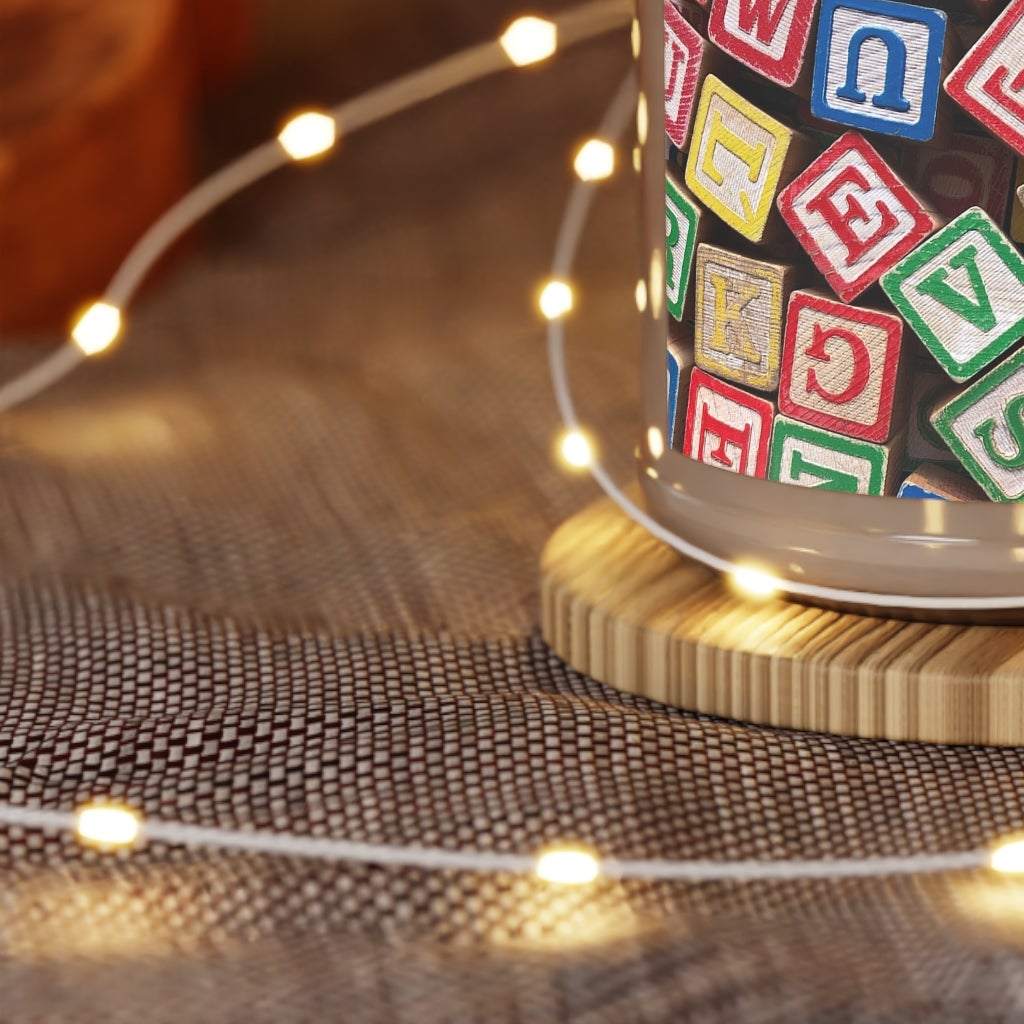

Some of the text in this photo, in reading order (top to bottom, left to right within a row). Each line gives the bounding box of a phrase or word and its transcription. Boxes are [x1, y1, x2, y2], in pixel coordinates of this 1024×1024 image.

[836, 25, 911, 112] U
[703, 110, 767, 185] L
[806, 165, 899, 266] E
[708, 272, 762, 363] K
[915, 244, 997, 332] V
[806, 322, 871, 404] G
